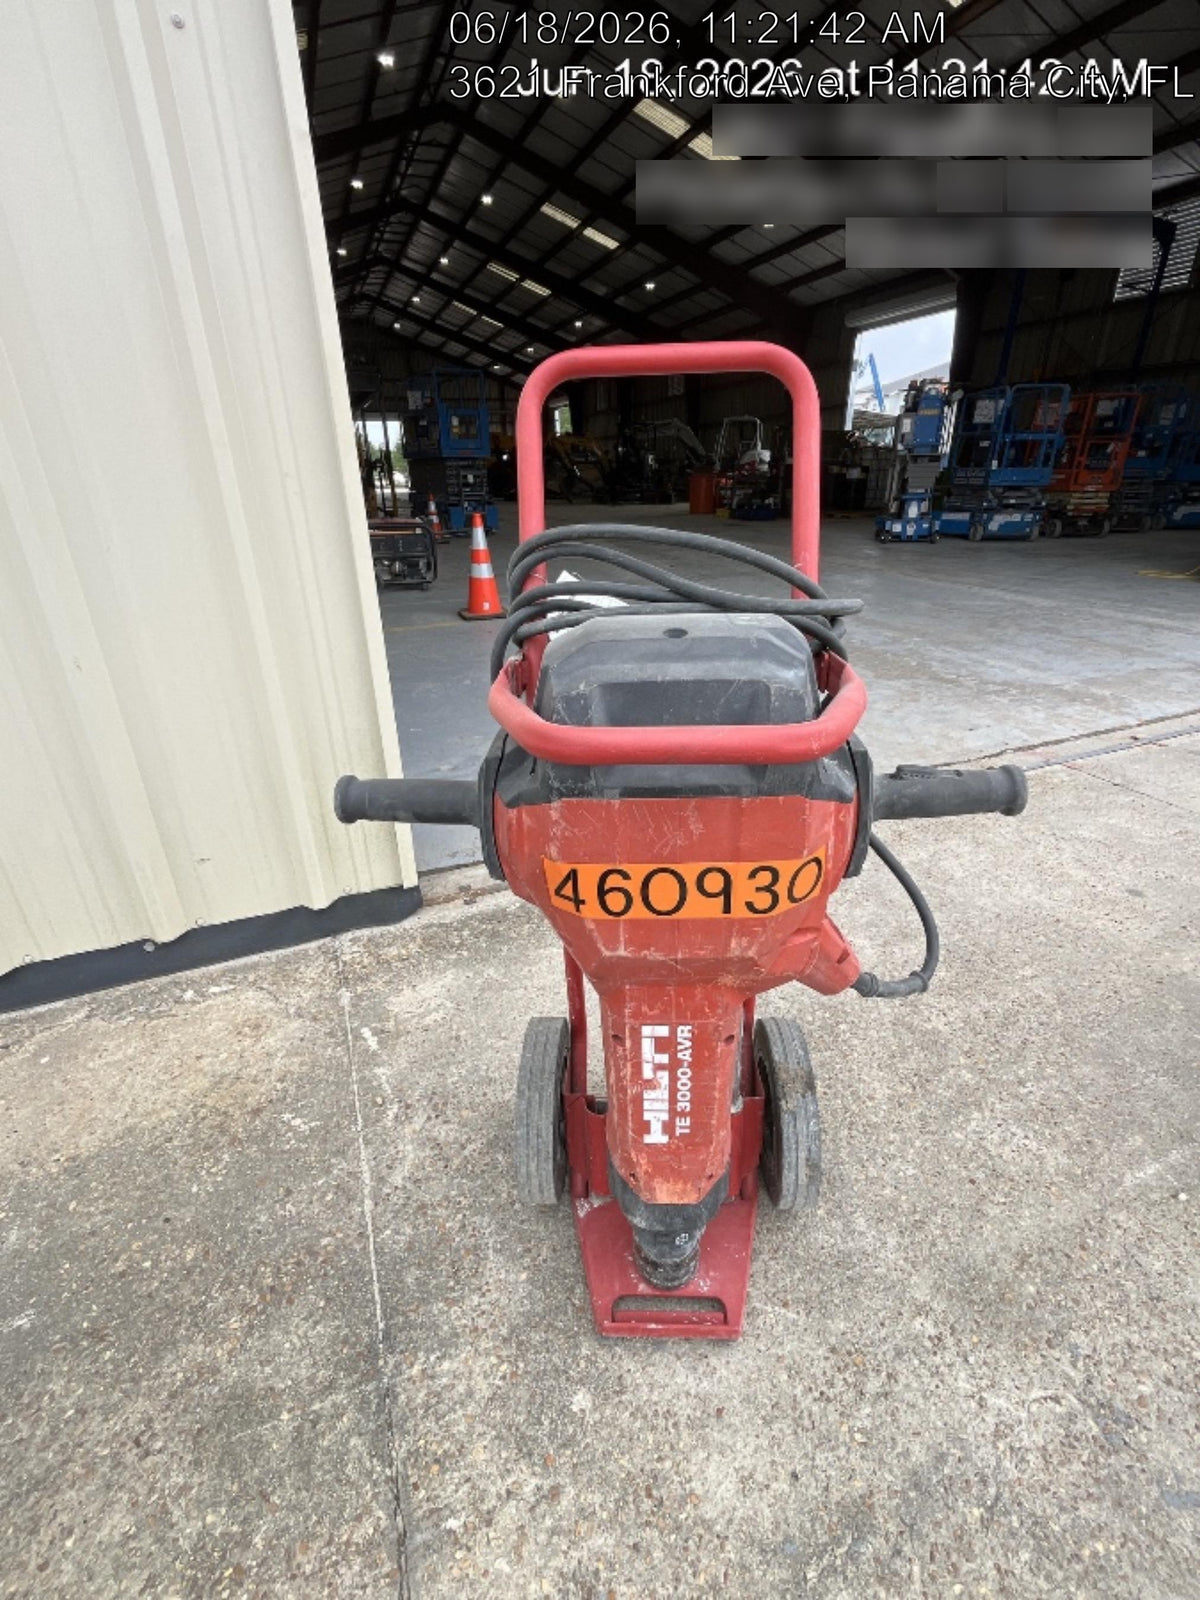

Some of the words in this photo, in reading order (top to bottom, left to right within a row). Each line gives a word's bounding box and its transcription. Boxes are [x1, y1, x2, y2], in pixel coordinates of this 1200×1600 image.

[554, 856, 823, 918] 460930
[641, 1024, 670, 1144] HILTI
[676, 1025, 693, 1112] 3000-AVR
[675, 1116, 691, 1137] TE
